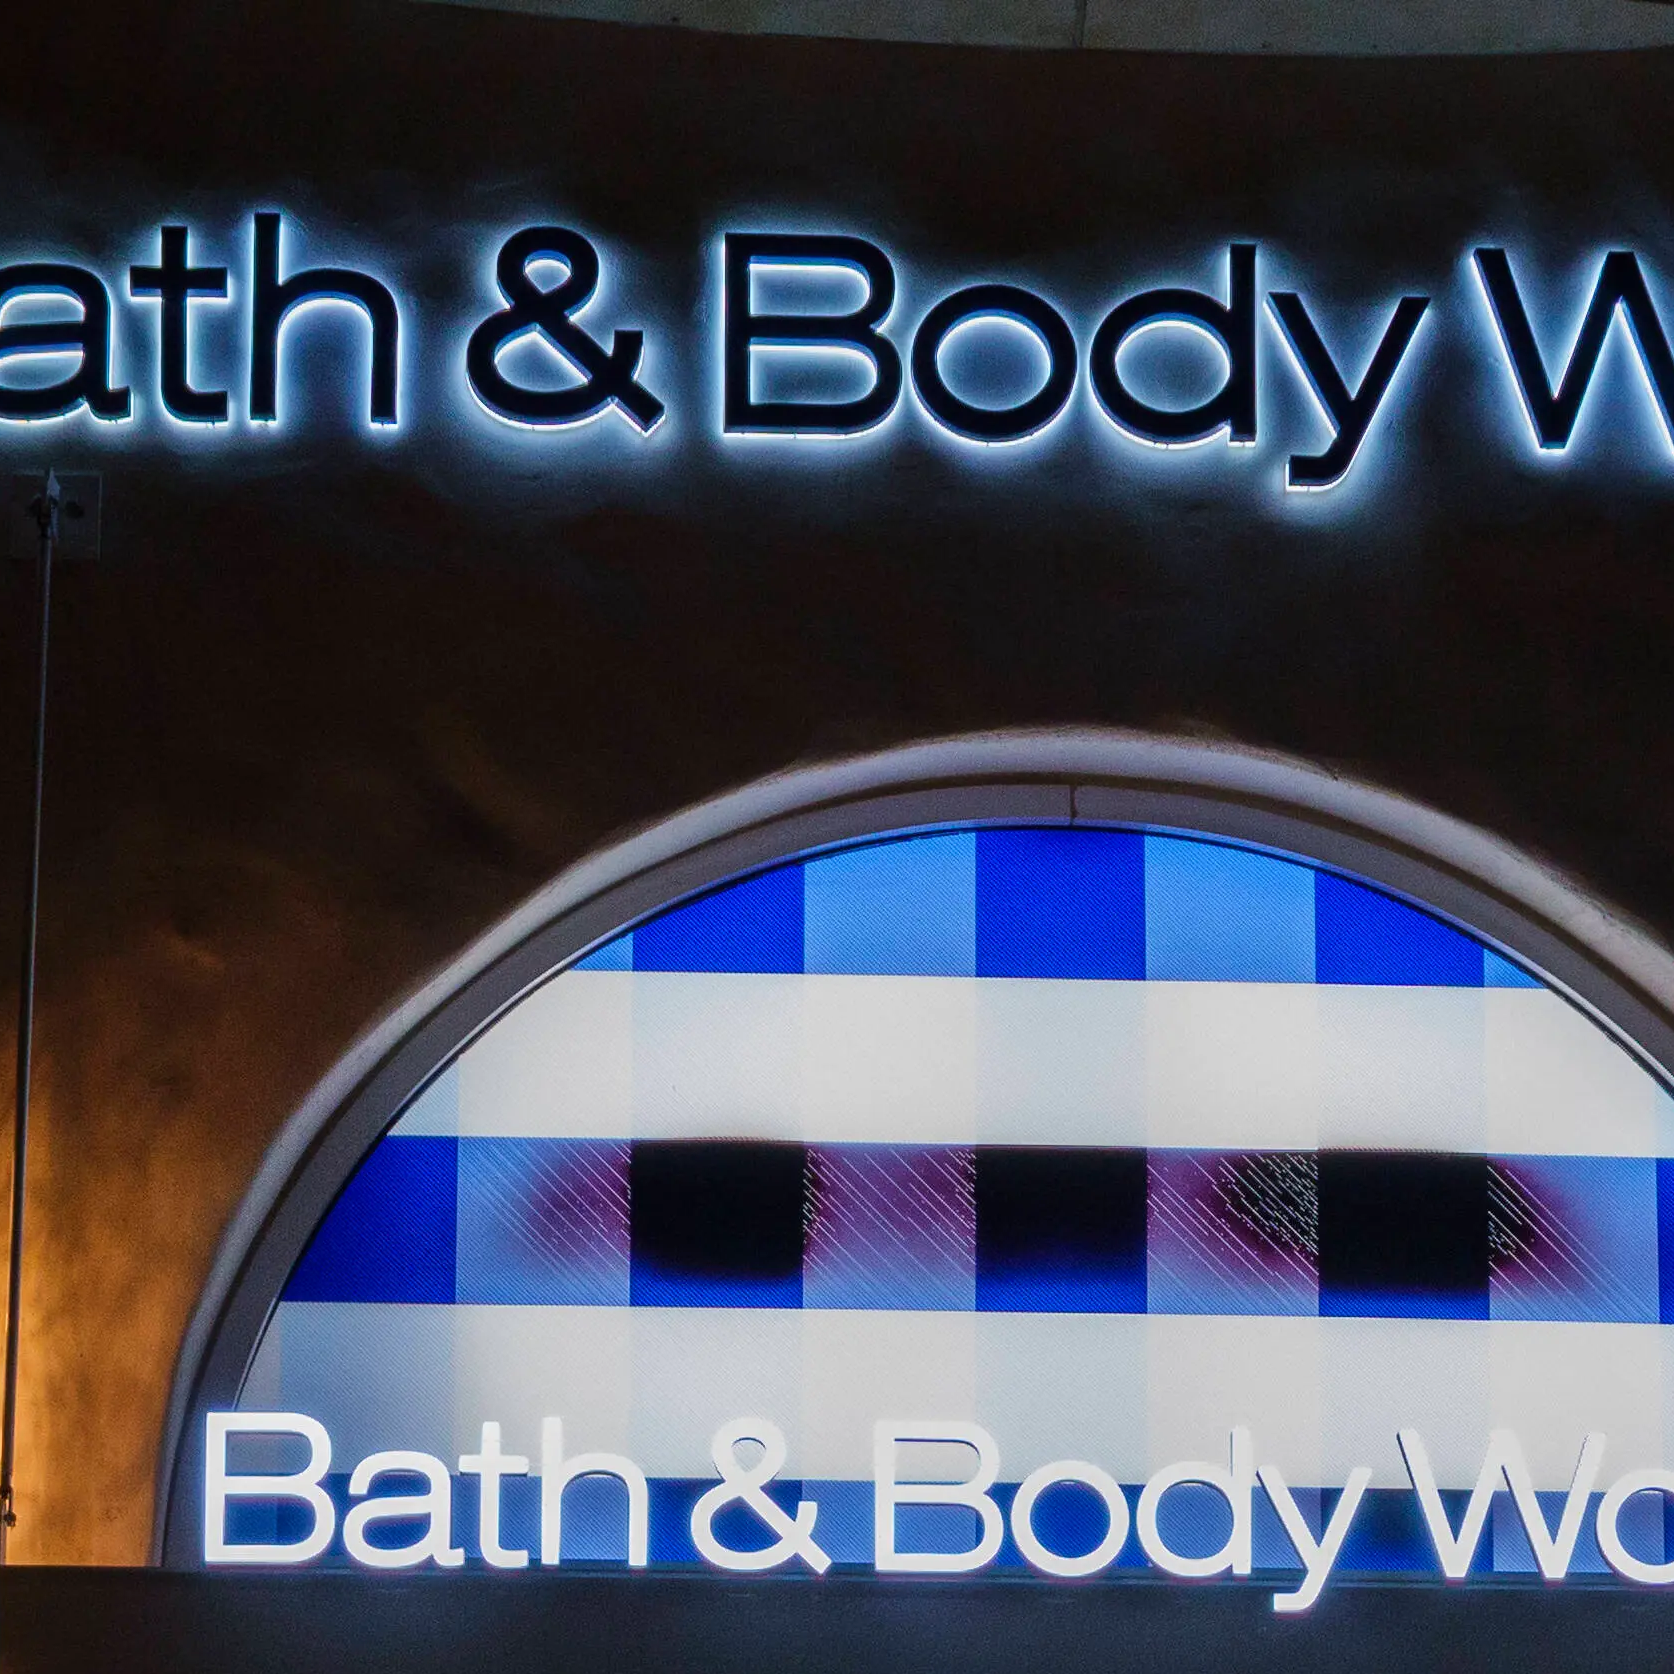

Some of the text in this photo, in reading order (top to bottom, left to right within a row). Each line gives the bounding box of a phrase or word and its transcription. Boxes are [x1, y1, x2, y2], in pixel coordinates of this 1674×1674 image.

[466, 226, 666, 437] &
[722, 232, 1430, 491] Body
[203, 1412, 648, 1569] Bath
[690, 1417, 833, 1576] &
[874, 1420, 1373, 1612] Body
